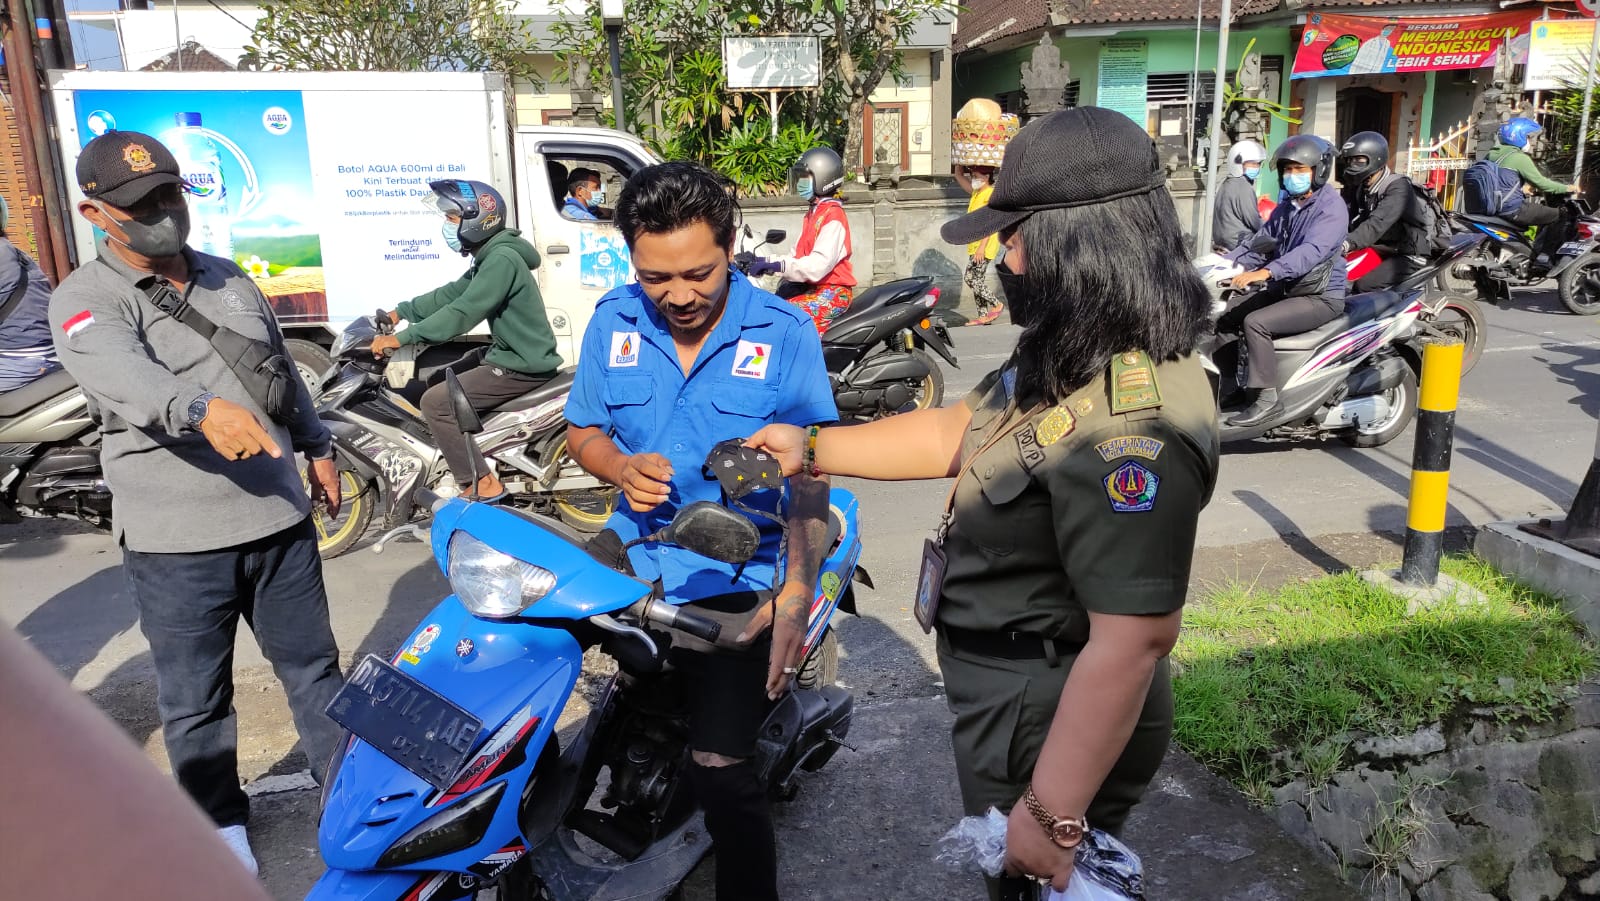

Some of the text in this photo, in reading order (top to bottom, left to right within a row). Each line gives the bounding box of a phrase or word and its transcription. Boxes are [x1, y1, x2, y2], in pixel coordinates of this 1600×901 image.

[1406, 23, 1460, 31] BERSAMA
[1398, 26, 1520, 43] MEMBANGUN
[1392, 40, 1491, 56] INDONESIA
[1386, 54, 1482, 68] LEBIH SEHAT
[266, 113, 288, 122] AQUA
[338, 164, 466, 174] Botol AQUA 600ml di Bali
[363, 177, 382, 185] Kini
[386, 176, 422, 185] Terbuat
[345, 189, 372, 198] 100%
[375, 188, 407, 197] Plastik
[388, 239, 432, 247] Terlindungi
[384, 253, 440, 261] Melindungimu
[1101, 438, 1158, 452] PEMERINTAH
[351, 659, 387, 695] DK
[488, 850, 523, 878] YAMAHA
